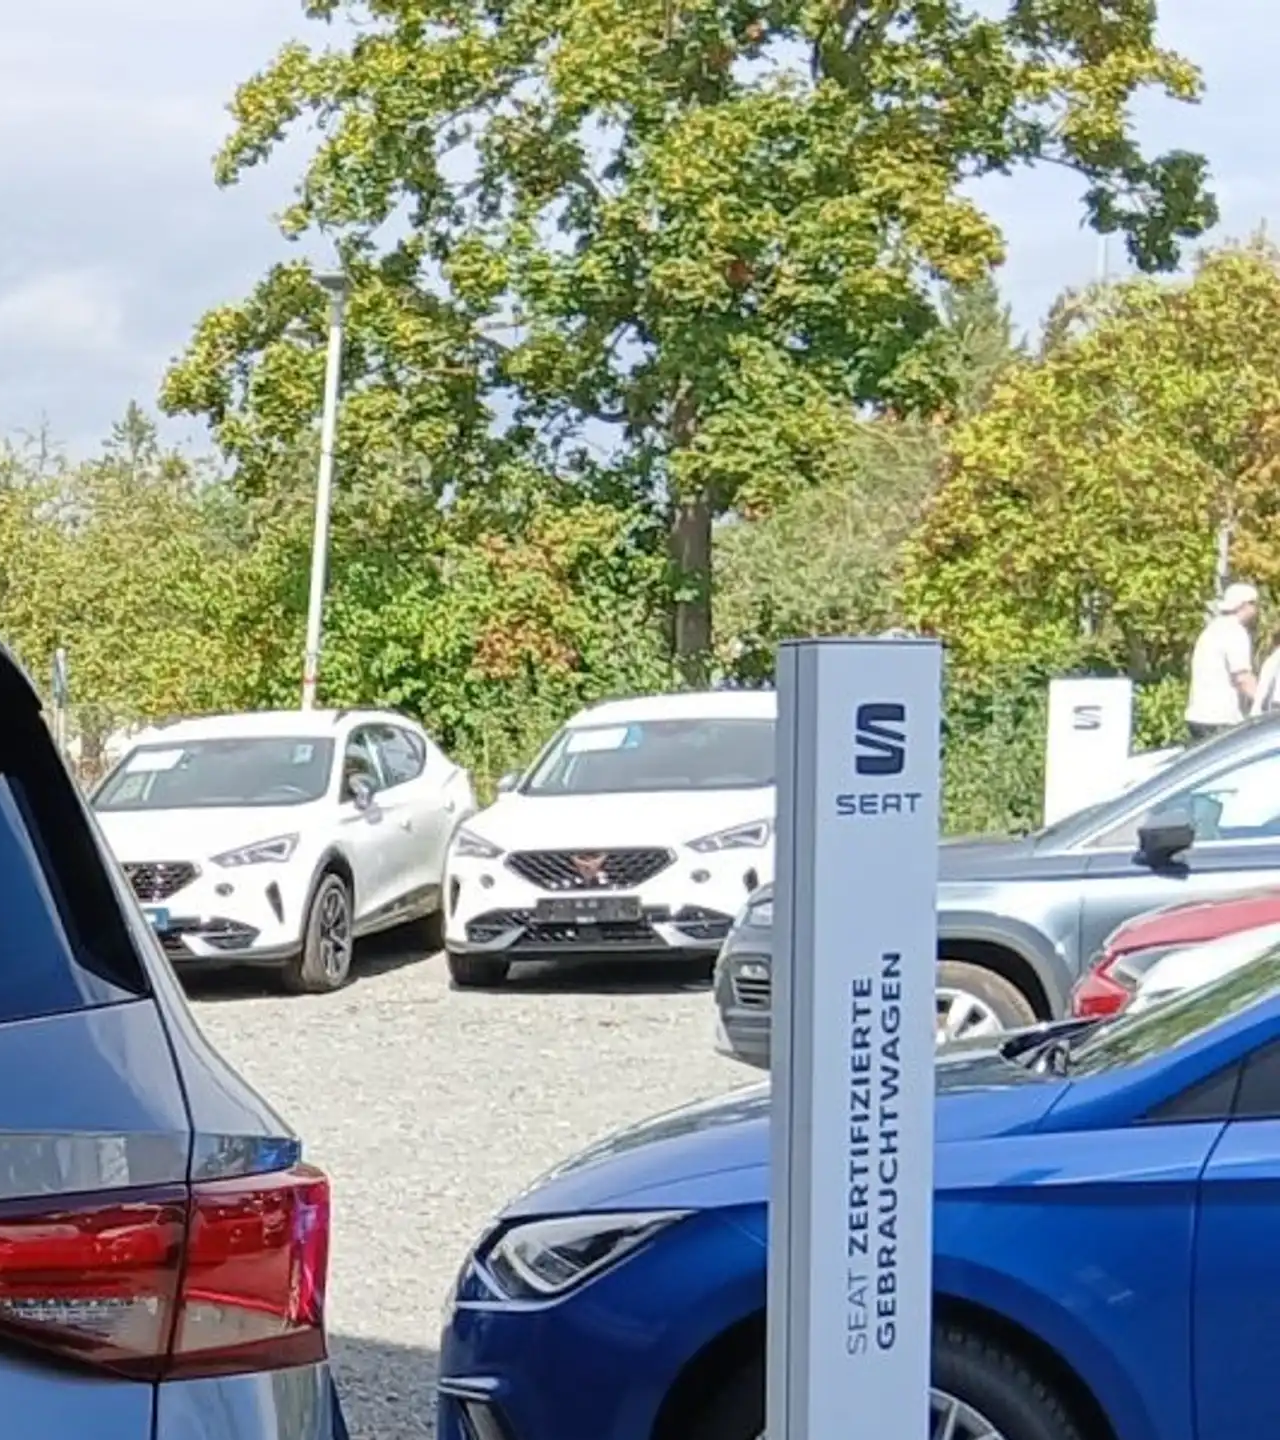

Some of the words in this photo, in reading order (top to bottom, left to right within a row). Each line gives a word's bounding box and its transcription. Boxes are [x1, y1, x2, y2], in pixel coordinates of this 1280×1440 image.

[834, 793, 922, 816] SEAT
[848, 976, 874, 1257] ZERTIFIZIERTE
[876, 952, 903, 1351] GEBRAUCHTWAGEN
[847, 1268, 870, 1357] SEAT
